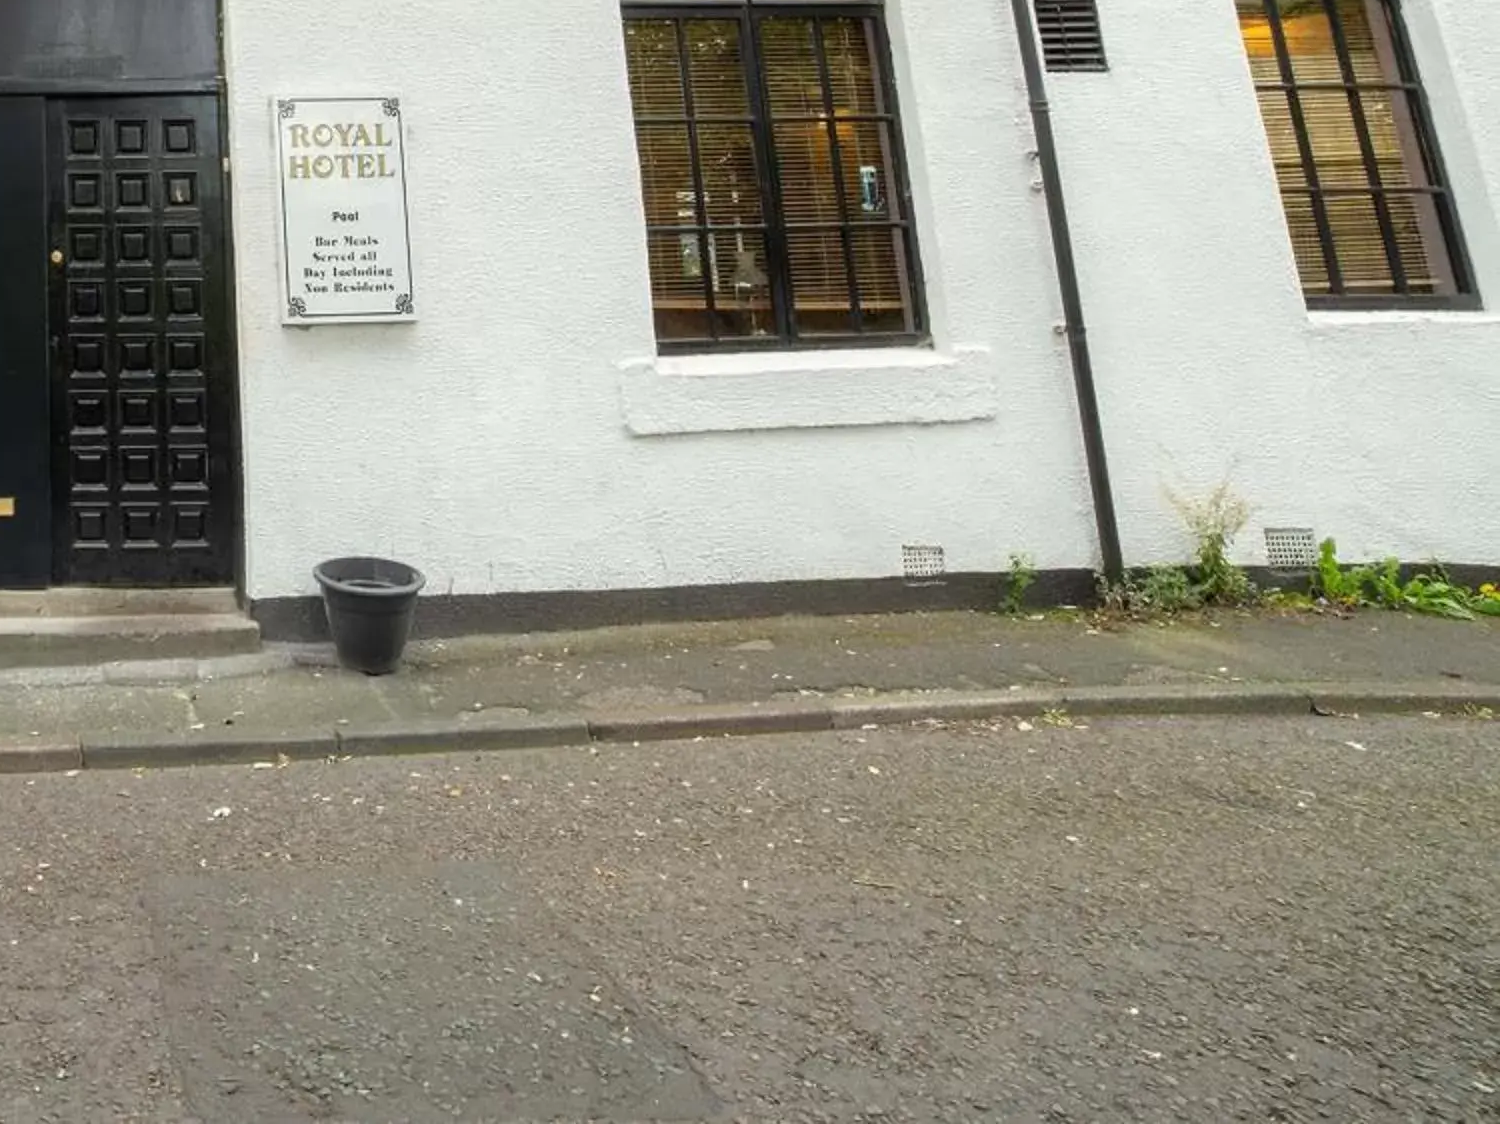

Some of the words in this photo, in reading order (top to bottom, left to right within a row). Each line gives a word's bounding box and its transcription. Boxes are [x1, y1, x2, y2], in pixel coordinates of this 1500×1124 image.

[289, 123, 392, 148] ROYAL
[289, 154, 395, 178] HOTEL
[332, 211, 358, 222] Pool
[315, 236, 338, 246] Bar
[344, 235, 379, 246] Meals
[313, 252, 354, 262] Served
[360, 251, 377, 261] all
[304, 268, 325, 279] Day
[333, 265, 393, 278] Including
[305, 283, 328, 293] Non
[334, 281, 395, 292] Residents
